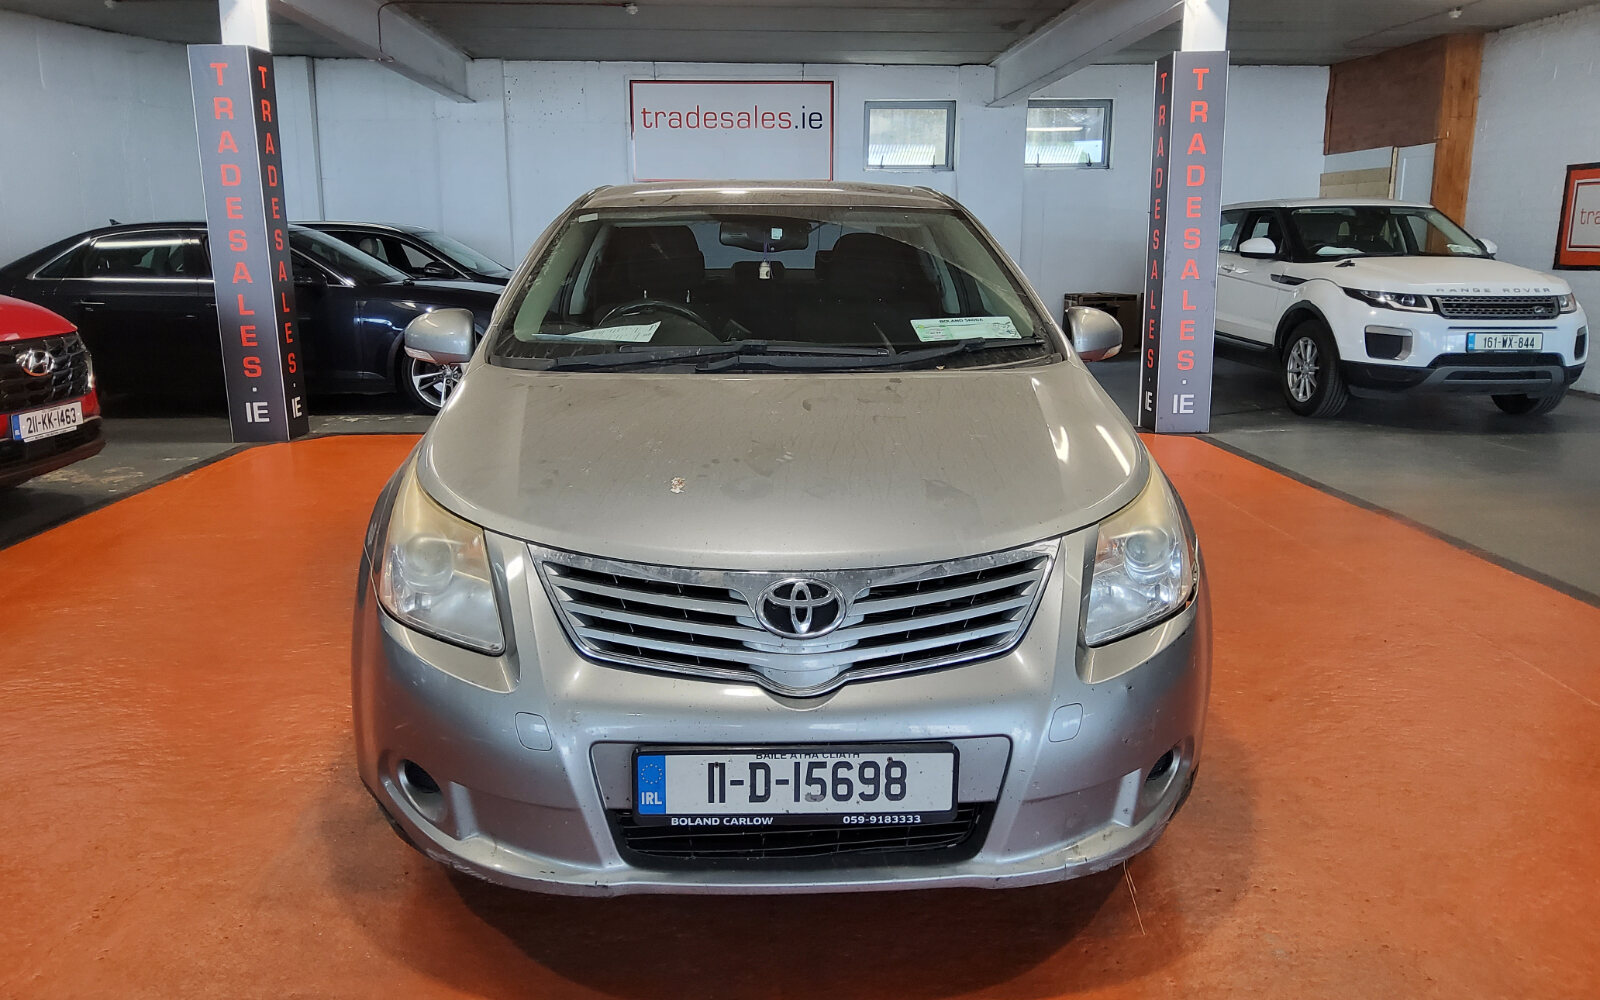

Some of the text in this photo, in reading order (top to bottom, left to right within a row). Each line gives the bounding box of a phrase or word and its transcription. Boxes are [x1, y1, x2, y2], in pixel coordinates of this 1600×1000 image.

[641, 104, 823, 129] tradesales.ie
[1482, 336, 1536, 349] 161-WX-844
[26, 407, 77, 434] 211-KK-1463
[707, 760, 908, 804] 11-D-15698
[641, 791, 663, 805] IRL
[671, 816, 774, 826] BOLAND CARLOW
[842, 814, 922, 825] 059-9183333
